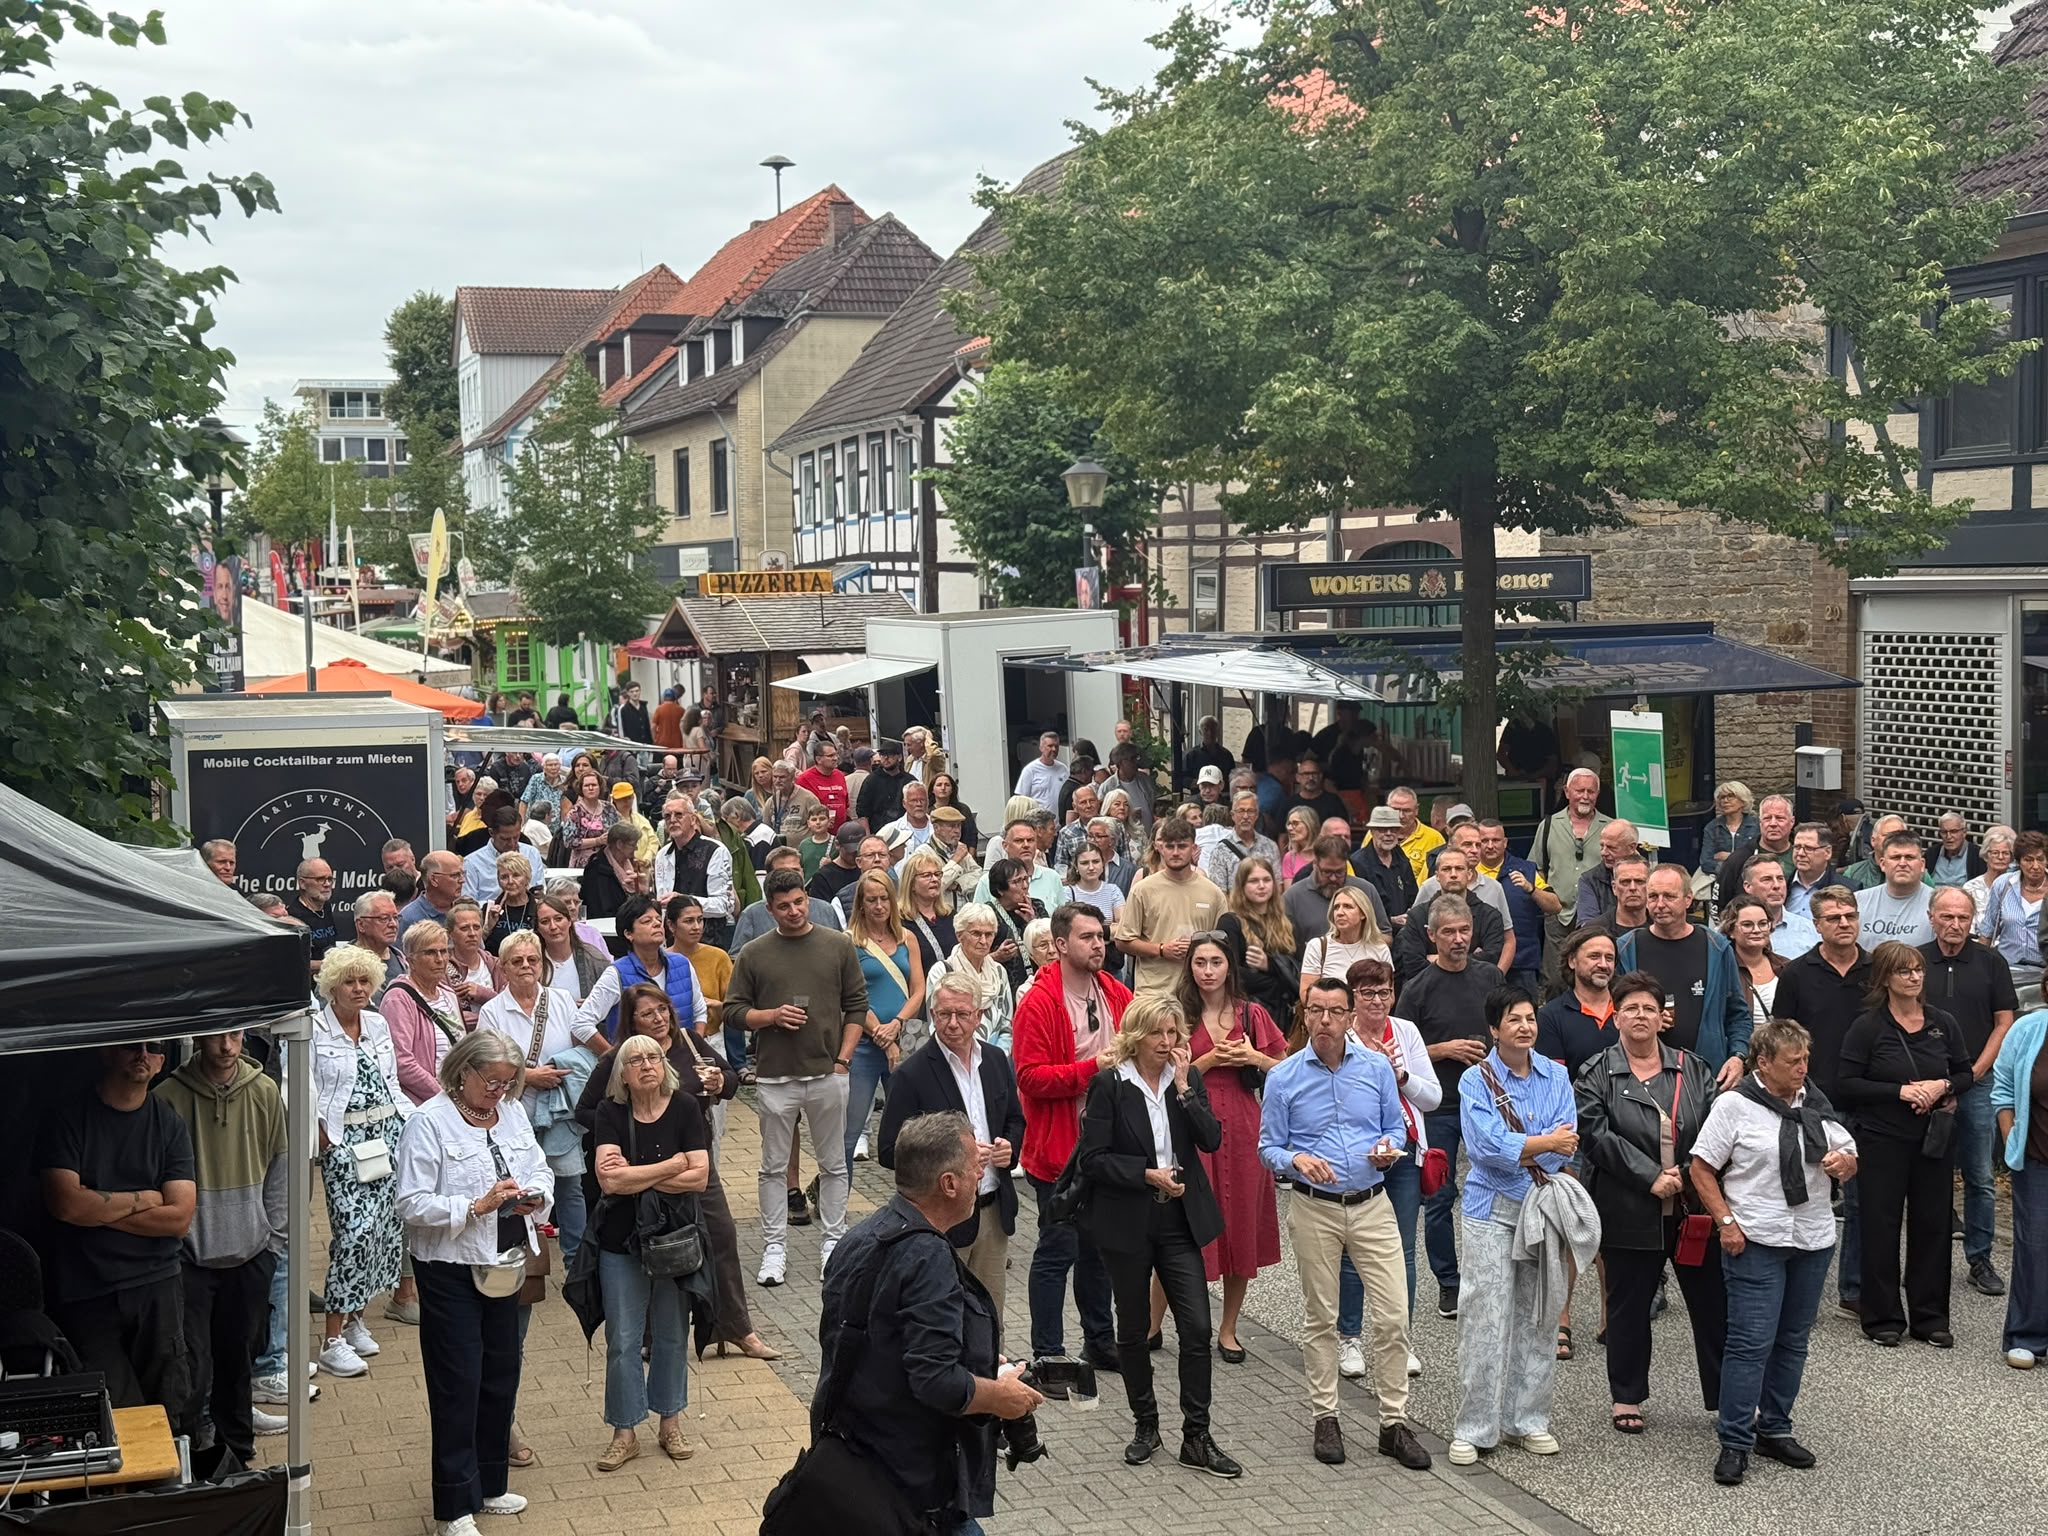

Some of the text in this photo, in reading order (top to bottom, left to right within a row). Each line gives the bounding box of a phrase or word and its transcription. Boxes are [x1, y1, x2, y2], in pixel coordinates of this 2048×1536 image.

[717, 573, 825, 593] PIZZERIA
[1309, 574, 1412, 596] WOLTERS
[1824, 605, 1840, 621] 20
[203, 754, 413, 768] Mobile Cocktailbar zum Mieten
[306, 795, 366, 820] EVENT
[1862, 919, 1919, 936] s.Oliver
